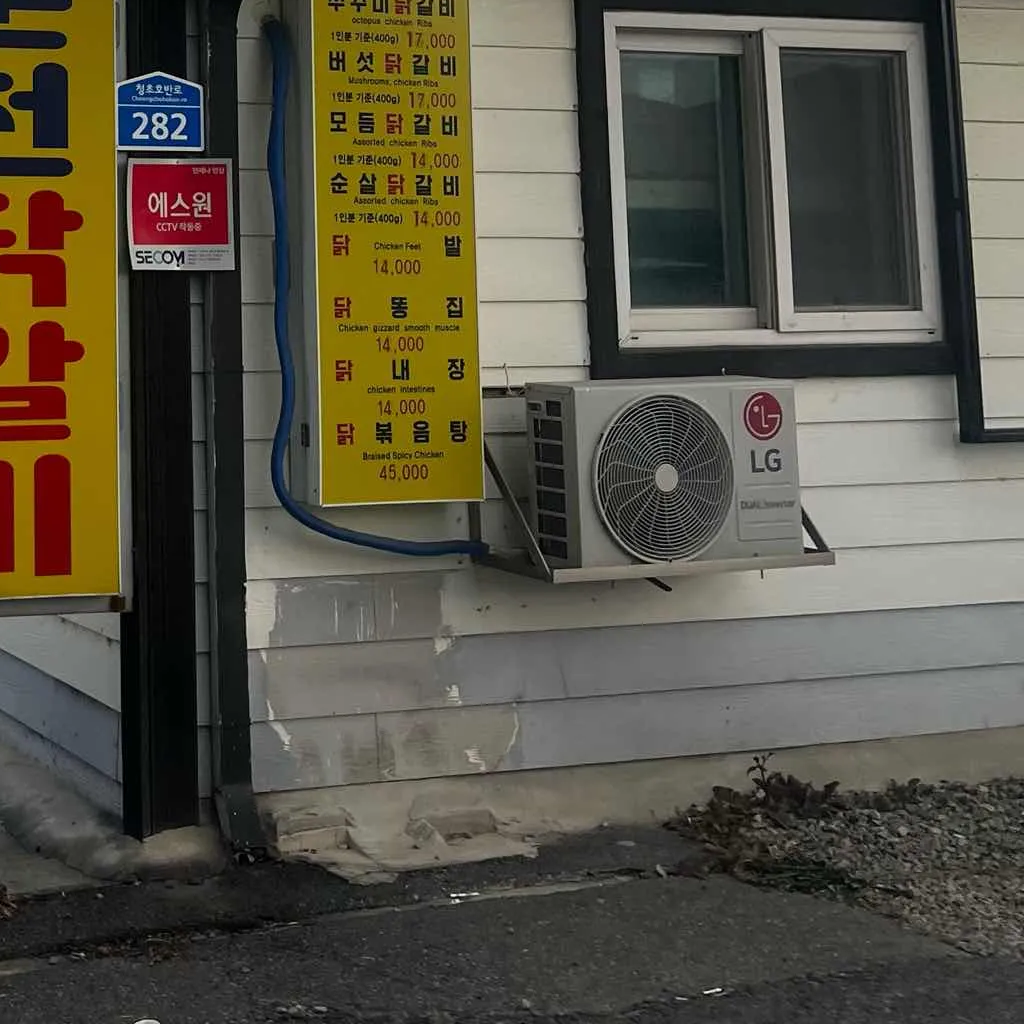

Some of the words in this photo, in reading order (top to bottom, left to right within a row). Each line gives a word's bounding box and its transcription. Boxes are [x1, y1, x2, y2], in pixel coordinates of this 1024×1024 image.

[351, 17, 381, 26] octopus
[384, 18, 413, 26] chicken
[407, 31, 456, 49] 17,000
[136, 83, 183, 96] 청초호반로
[393, 79, 422, 87] chicken
[408, 92, 456, 109] 17,000
[132, 112, 188, 141] 282
[352, 138, 385, 146] Assorted
[389, 139, 418, 147] chicken
[411, 152, 460, 170] 14,000
[148, 191, 212, 219] 에스원
[353, 196, 386, 205] Assorted
[390, 197, 419, 206] chicken
[156, 222, 178, 232] CCTV
[412, 210, 461, 228] 14,000
[374, 242, 404, 250] Chicken
[136, 250, 185, 265] SECOM
[373, 259, 421, 276] 14,000
[338, 324, 368, 333] Chicken
[376, 336, 424, 353] 14,000
[367, 385, 396, 394] chicken
[378, 399, 426, 417] 14,000
[392, 451, 413, 461] Spicy
[414, 450, 444, 459] Chicken
[750, 448, 782, 473] LG
[379, 464, 429, 481] 45,000
